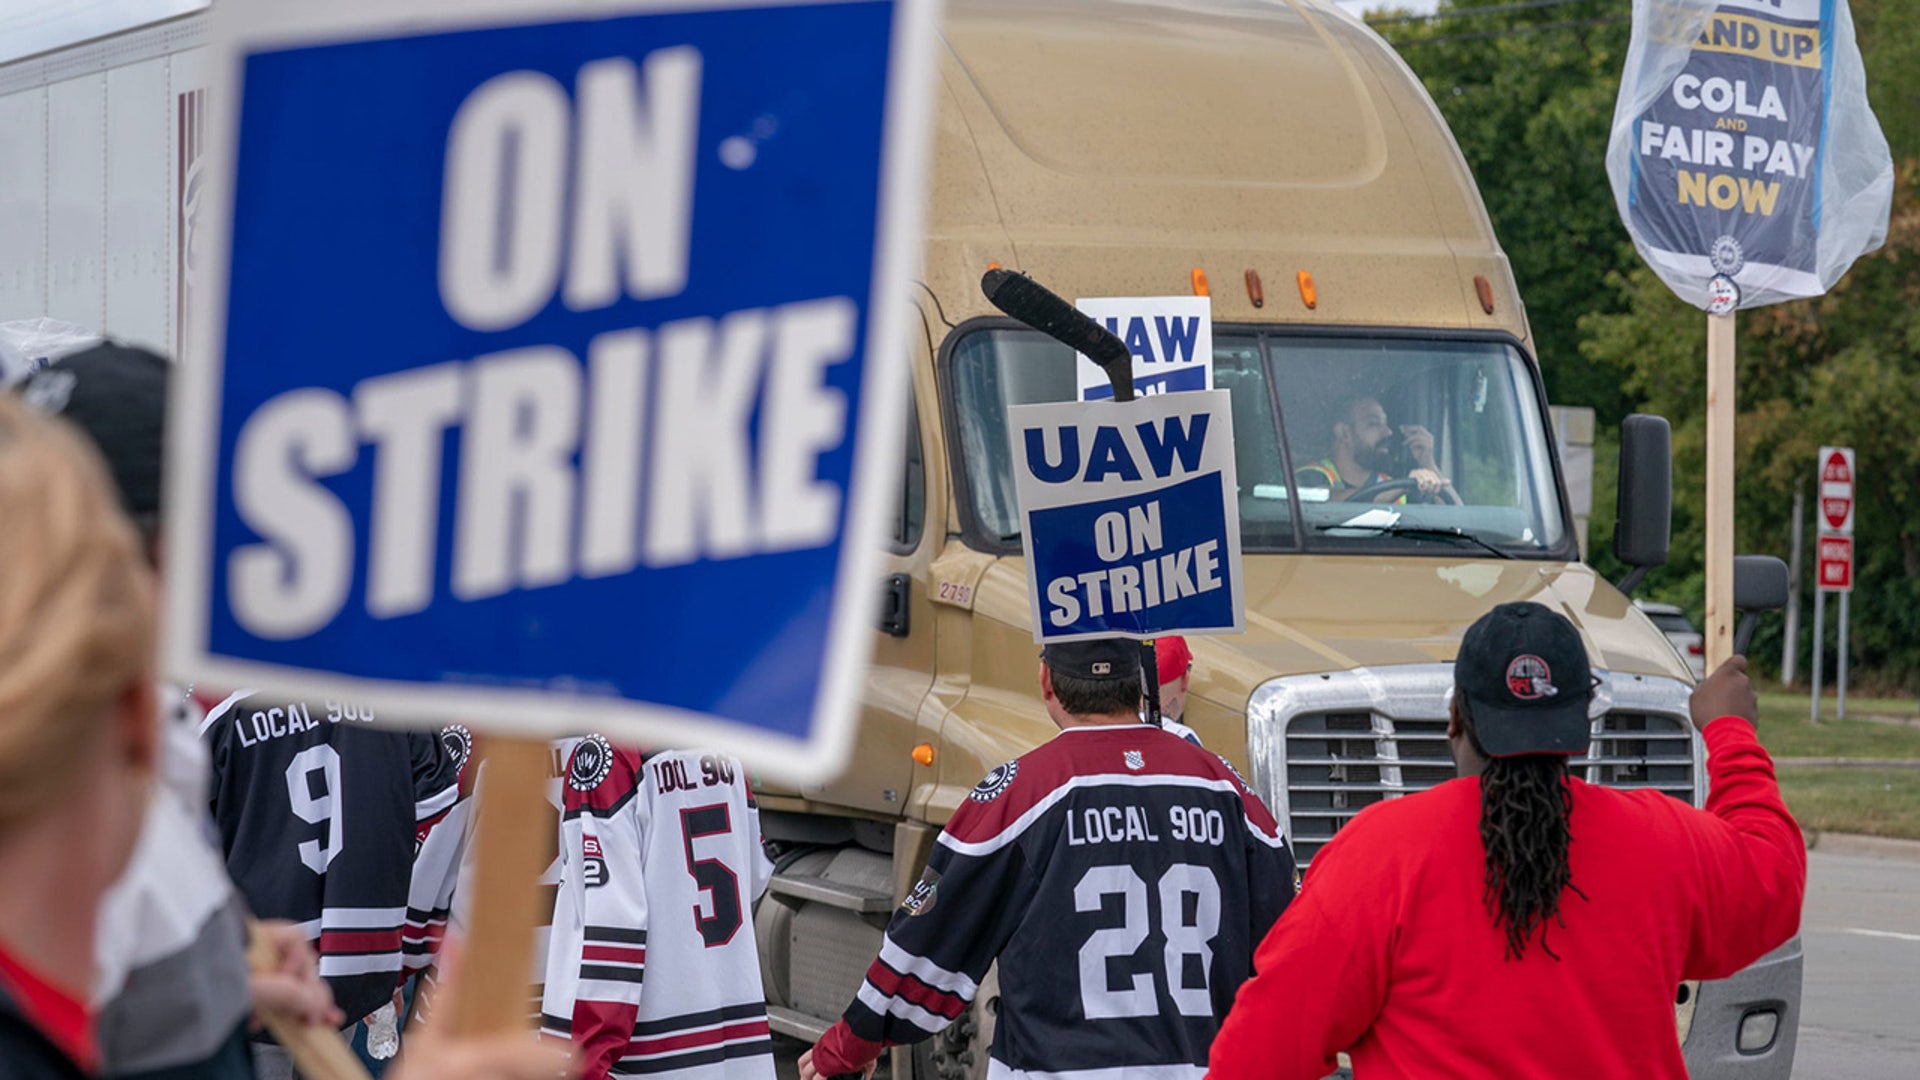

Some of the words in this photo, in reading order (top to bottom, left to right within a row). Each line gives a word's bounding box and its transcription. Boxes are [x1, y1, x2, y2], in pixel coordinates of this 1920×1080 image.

[1770, 29, 1814, 60] UP
[1673, 73, 1787, 121] COLA
[1715, 117, 1747, 132] AND
[1641, 121, 1733, 168] FAIR
[1743, 135, 1815, 179] PAY
[438, 44, 703, 332] ON
[1678, 170, 1780, 216] NOW
[227, 296, 858, 641] STRIKE
[1024, 413, 1211, 484] UAW
[1094, 500, 1163, 562] ON
[1047, 539, 1223, 627] STRIKE
[235, 702, 320, 748] LOCAL
[285, 743, 343, 875] 9
[1067, 806, 1159, 846] LOCAL
[1169, 805, 1225, 846] 900
[679, 802, 744, 948] 5
[1073, 862, 1222, 1020] 28
